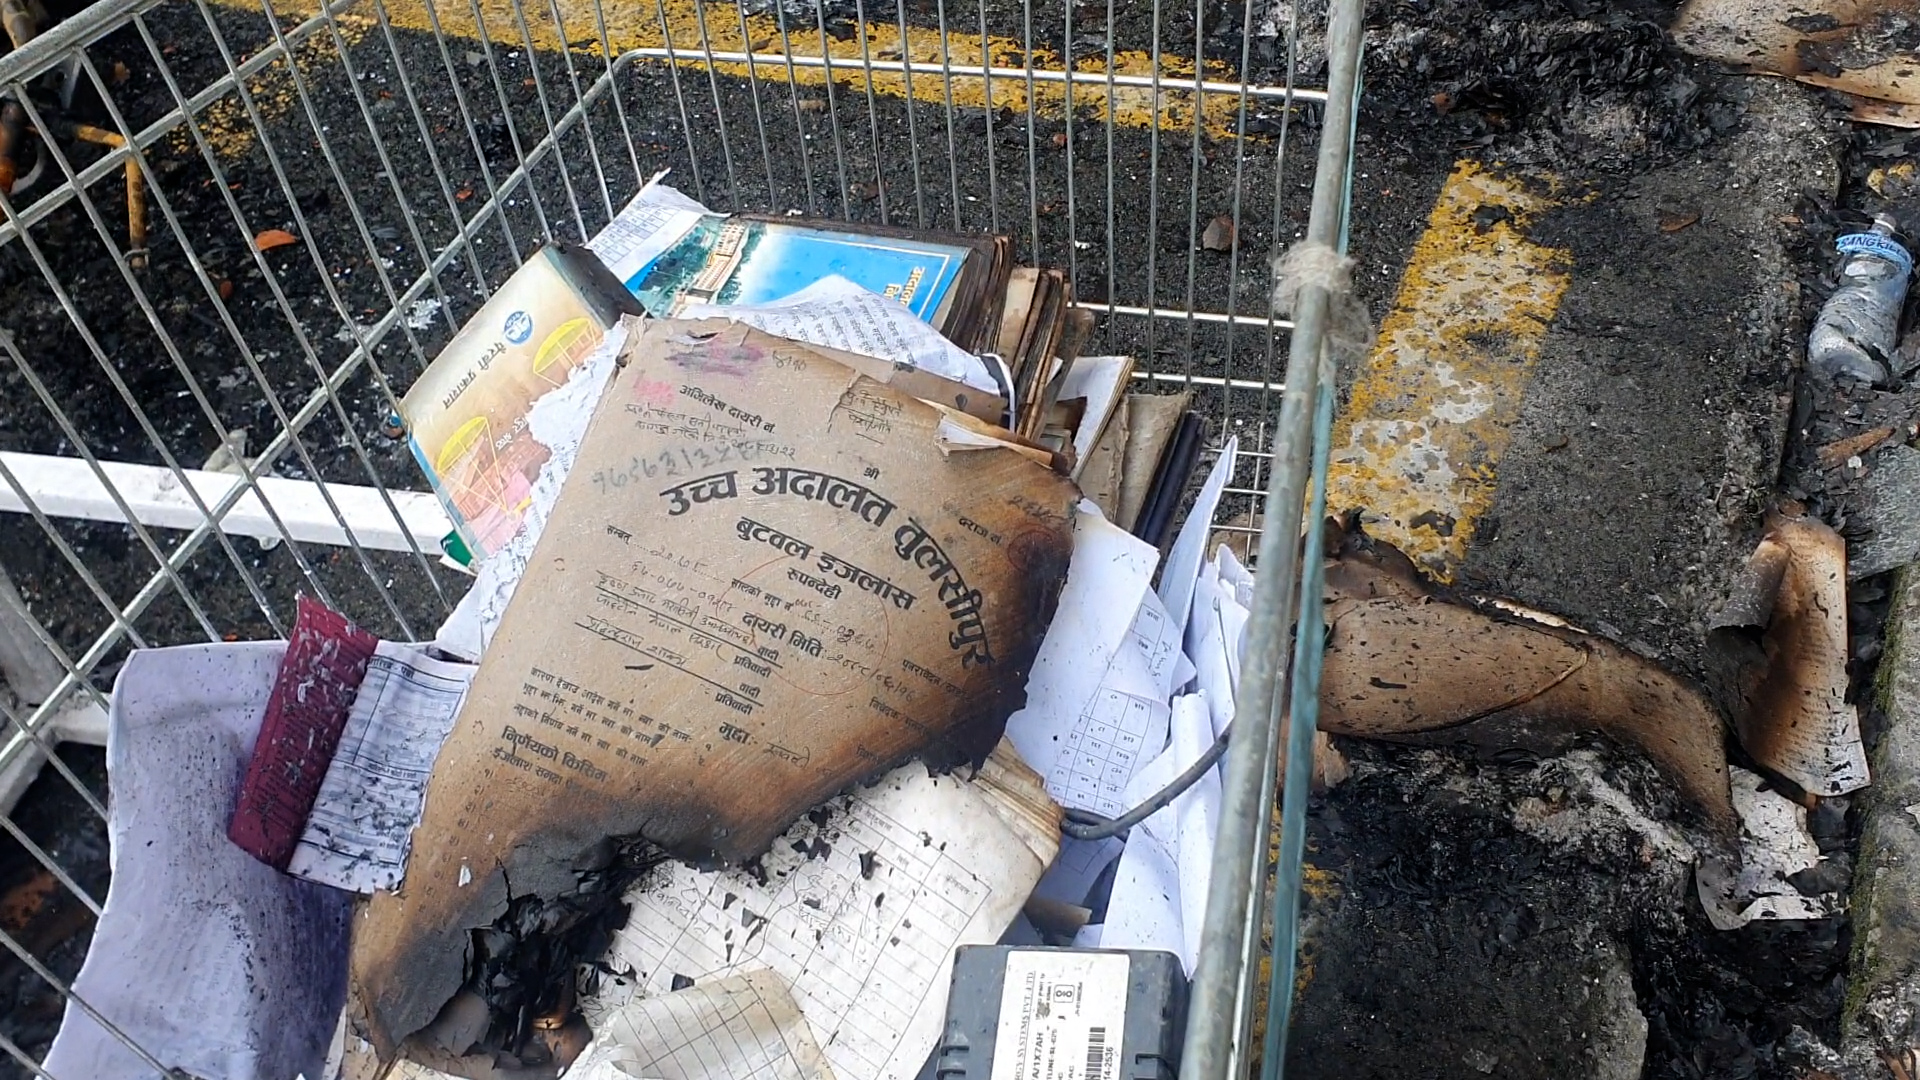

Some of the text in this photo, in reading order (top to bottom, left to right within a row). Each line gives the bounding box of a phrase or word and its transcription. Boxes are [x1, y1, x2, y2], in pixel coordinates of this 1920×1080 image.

[439, 368, 479, 410] प्रकाशन
[678, 380, 728, 413] अभिलेख
[725, 402, 763, 429] दायरी
[862, 464, 881, 481] श्री
[735, 515, 813, 562] बुटवल
[659, 465, 995, 667] उच्च अदालत तुलसीपुर
[729, 575, 763, 598] सालको
[740, 606, 788, 642] दायरी
[730, 652, 773, 679] प्रतिवादी
[755, 642, 780, 663] वादी
[737, 679, 762, 699] वादी
[713, 690, 755, 716] प्रतिवादी
